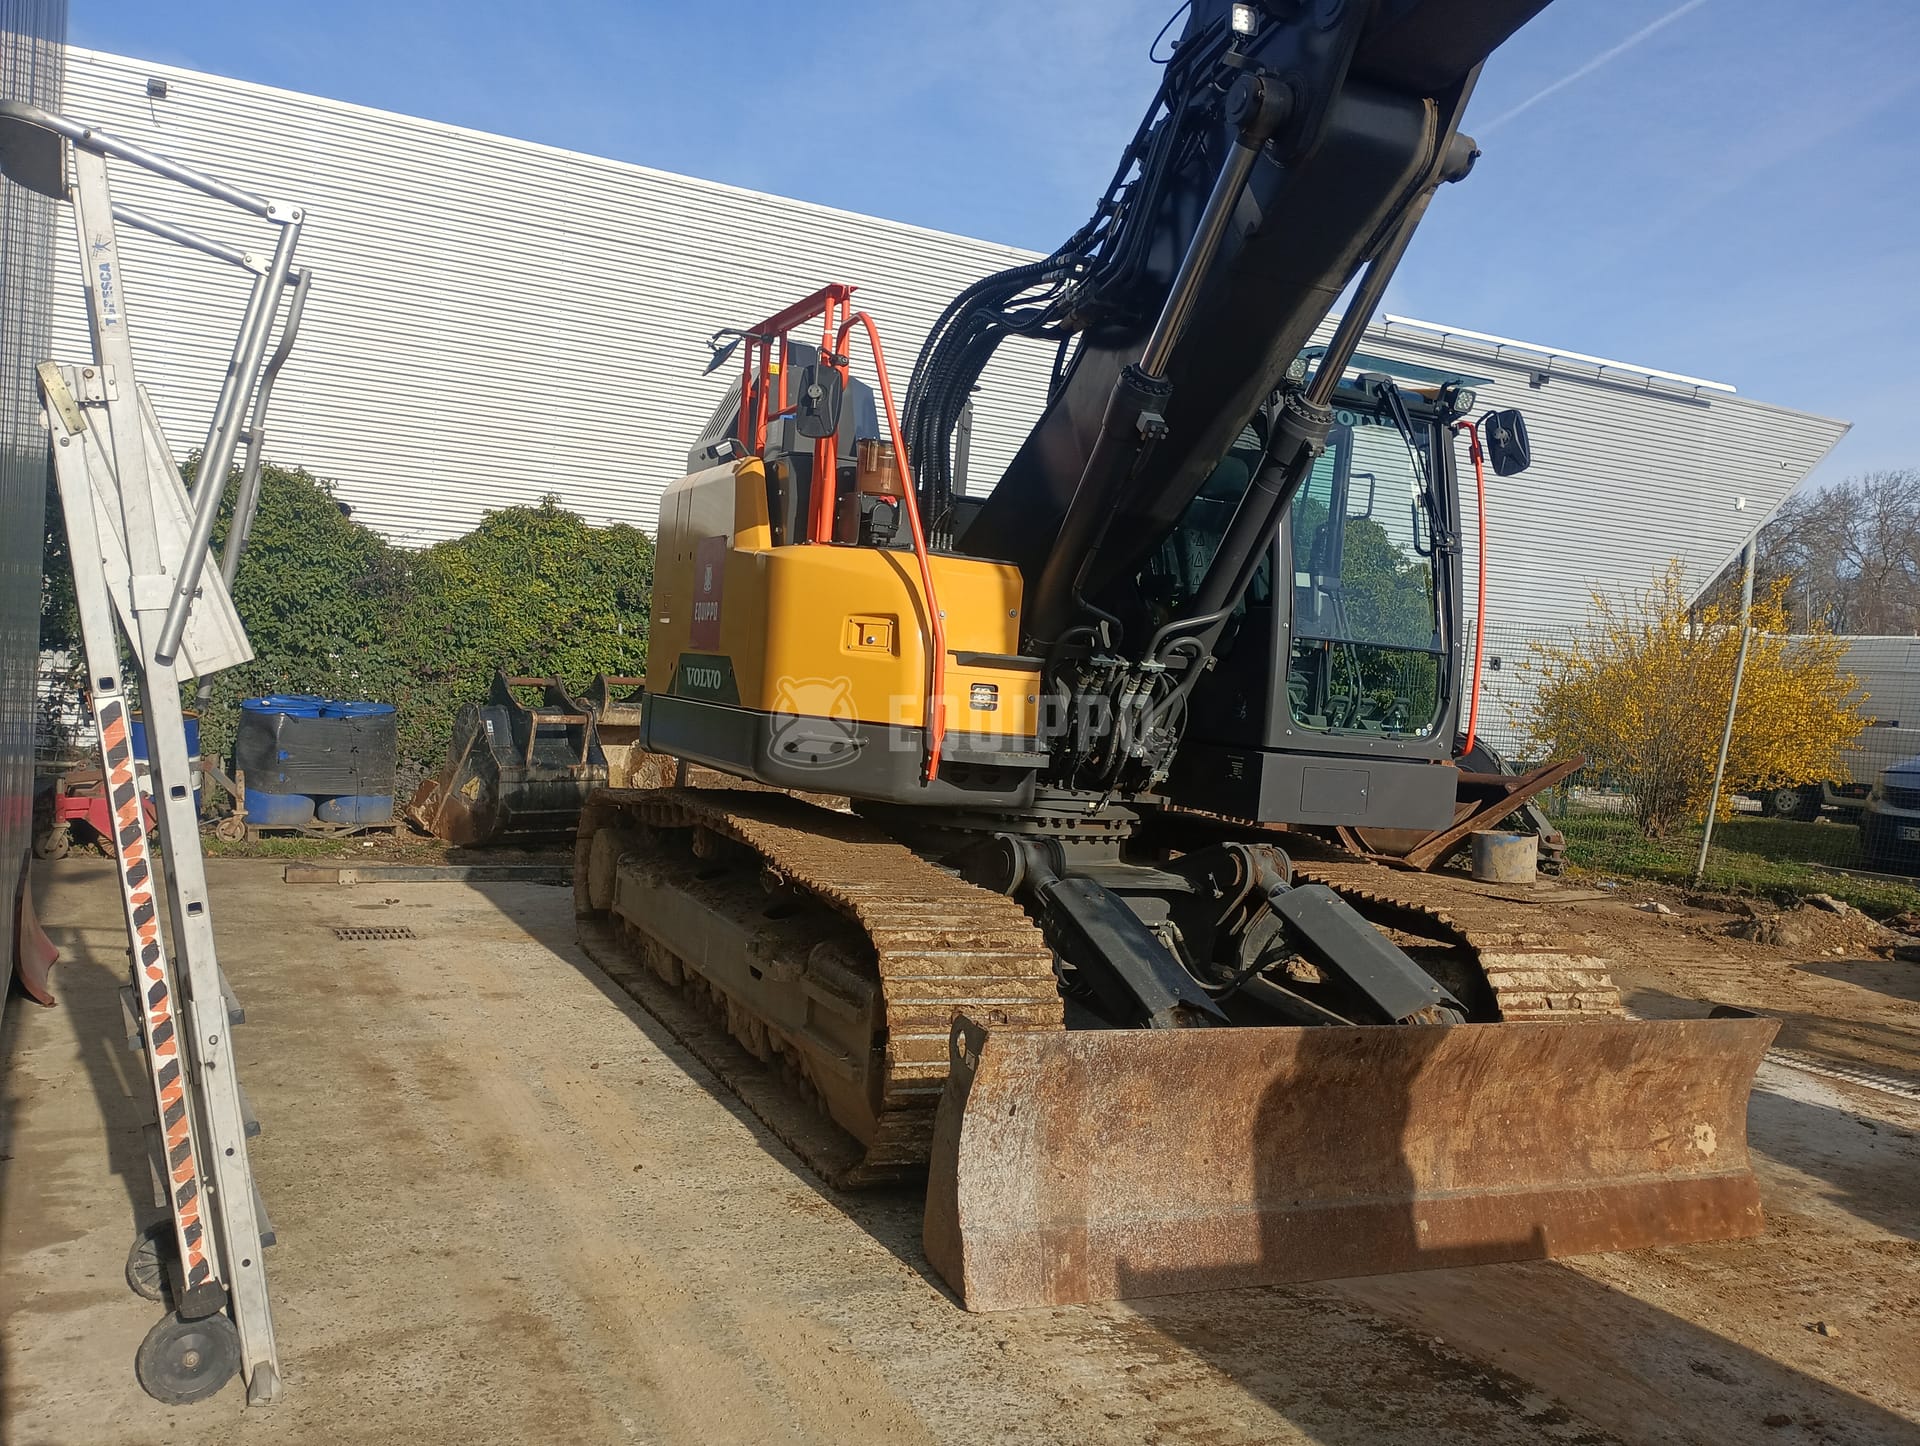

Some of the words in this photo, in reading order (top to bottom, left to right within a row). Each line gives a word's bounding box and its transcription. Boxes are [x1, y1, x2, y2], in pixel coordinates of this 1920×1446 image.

[1332, 409, 1395, 426] OLV
[694, 602, 719, 623] EQUIPPO
[686, 667, 721, 690] VOLVO
[1904, 828, 1920, 839] FC-
